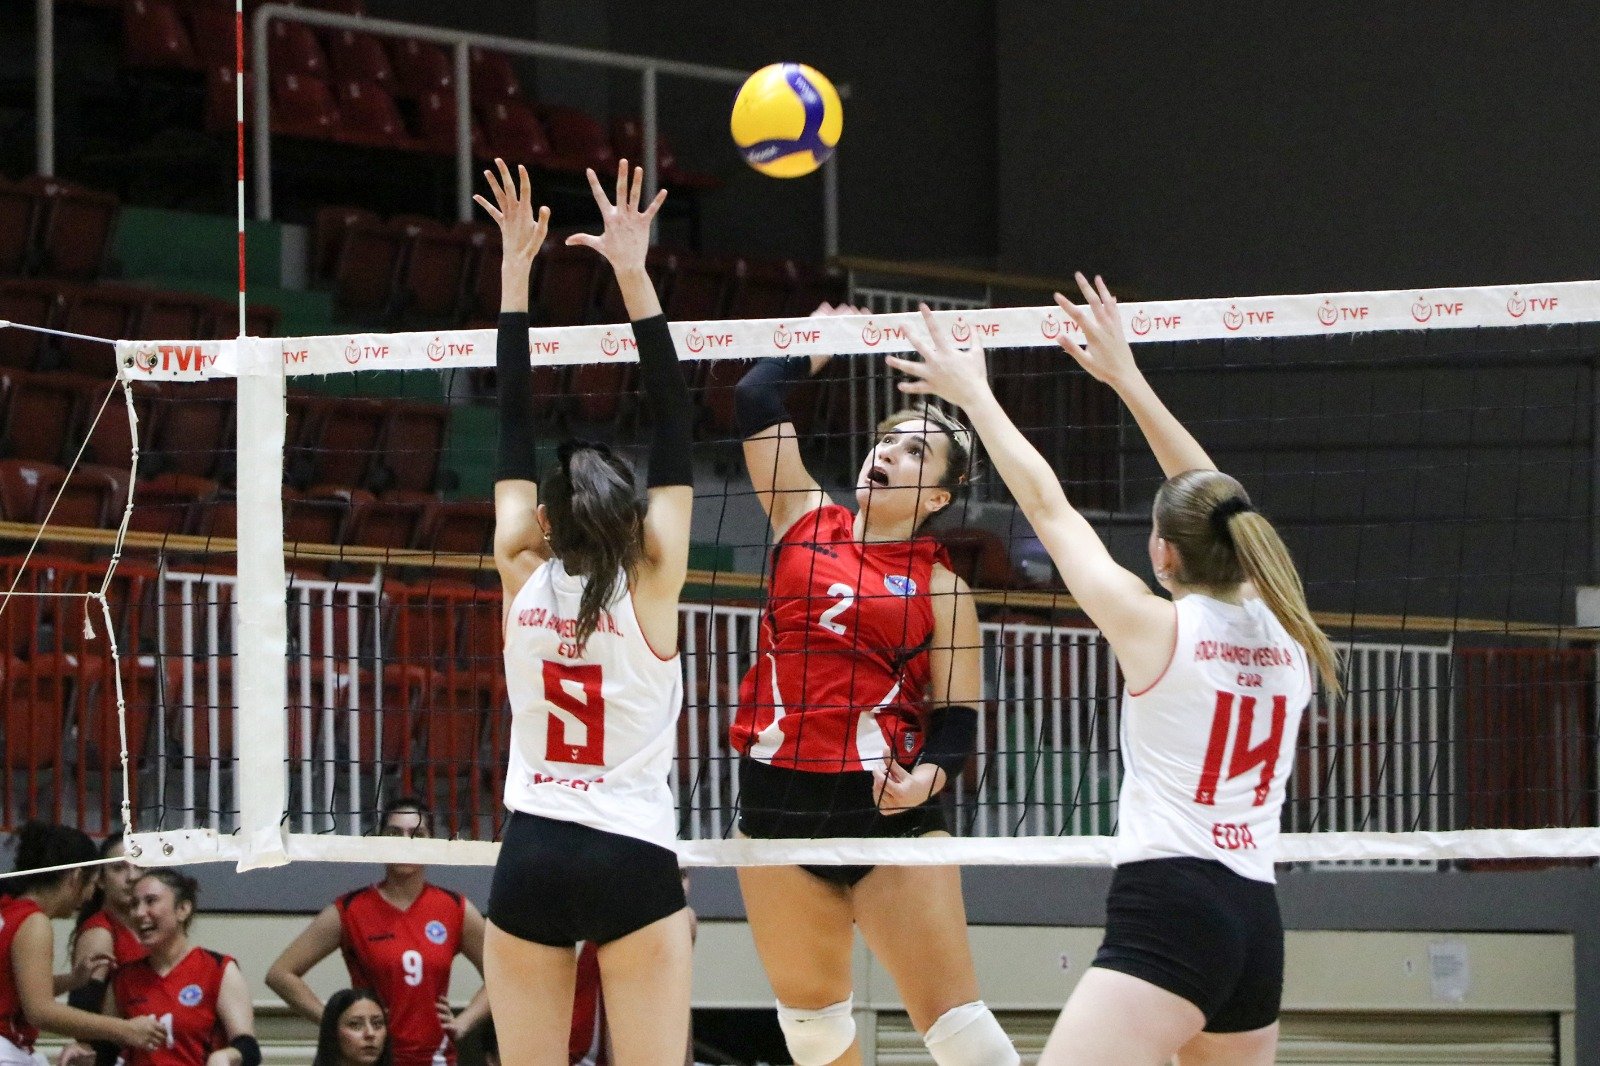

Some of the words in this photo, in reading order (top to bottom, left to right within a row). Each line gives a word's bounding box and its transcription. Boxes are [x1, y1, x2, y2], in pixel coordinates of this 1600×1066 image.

[201, 354, 218, 369] TV
[283, 350, 309, 364] TVF
[363, 346, 390, 359] TVF
[448, 343, 474, 356] TVF
[534, 341, 560, 355] TVF
[620, 337, 638, 350] TV
[706, 334, 734, 348] TVF
[794, 330, 821, 344] TVF
[1153, 315, 1181, 330] TVF
[1246, 310, 1275, 325] TVF
[1340, 307, 1369, 321] TVF
[1434, 302, 1464, 317] TVF
[1529, 297, 1559, 312] TVF
[818, 582, 854, 636] 2
[542, 659, 605, 767] 9
[1194, 689, 1287, 807] 14
[1212, 823, 1257, 850] EDA
[402, 949, 424, 987] 9
